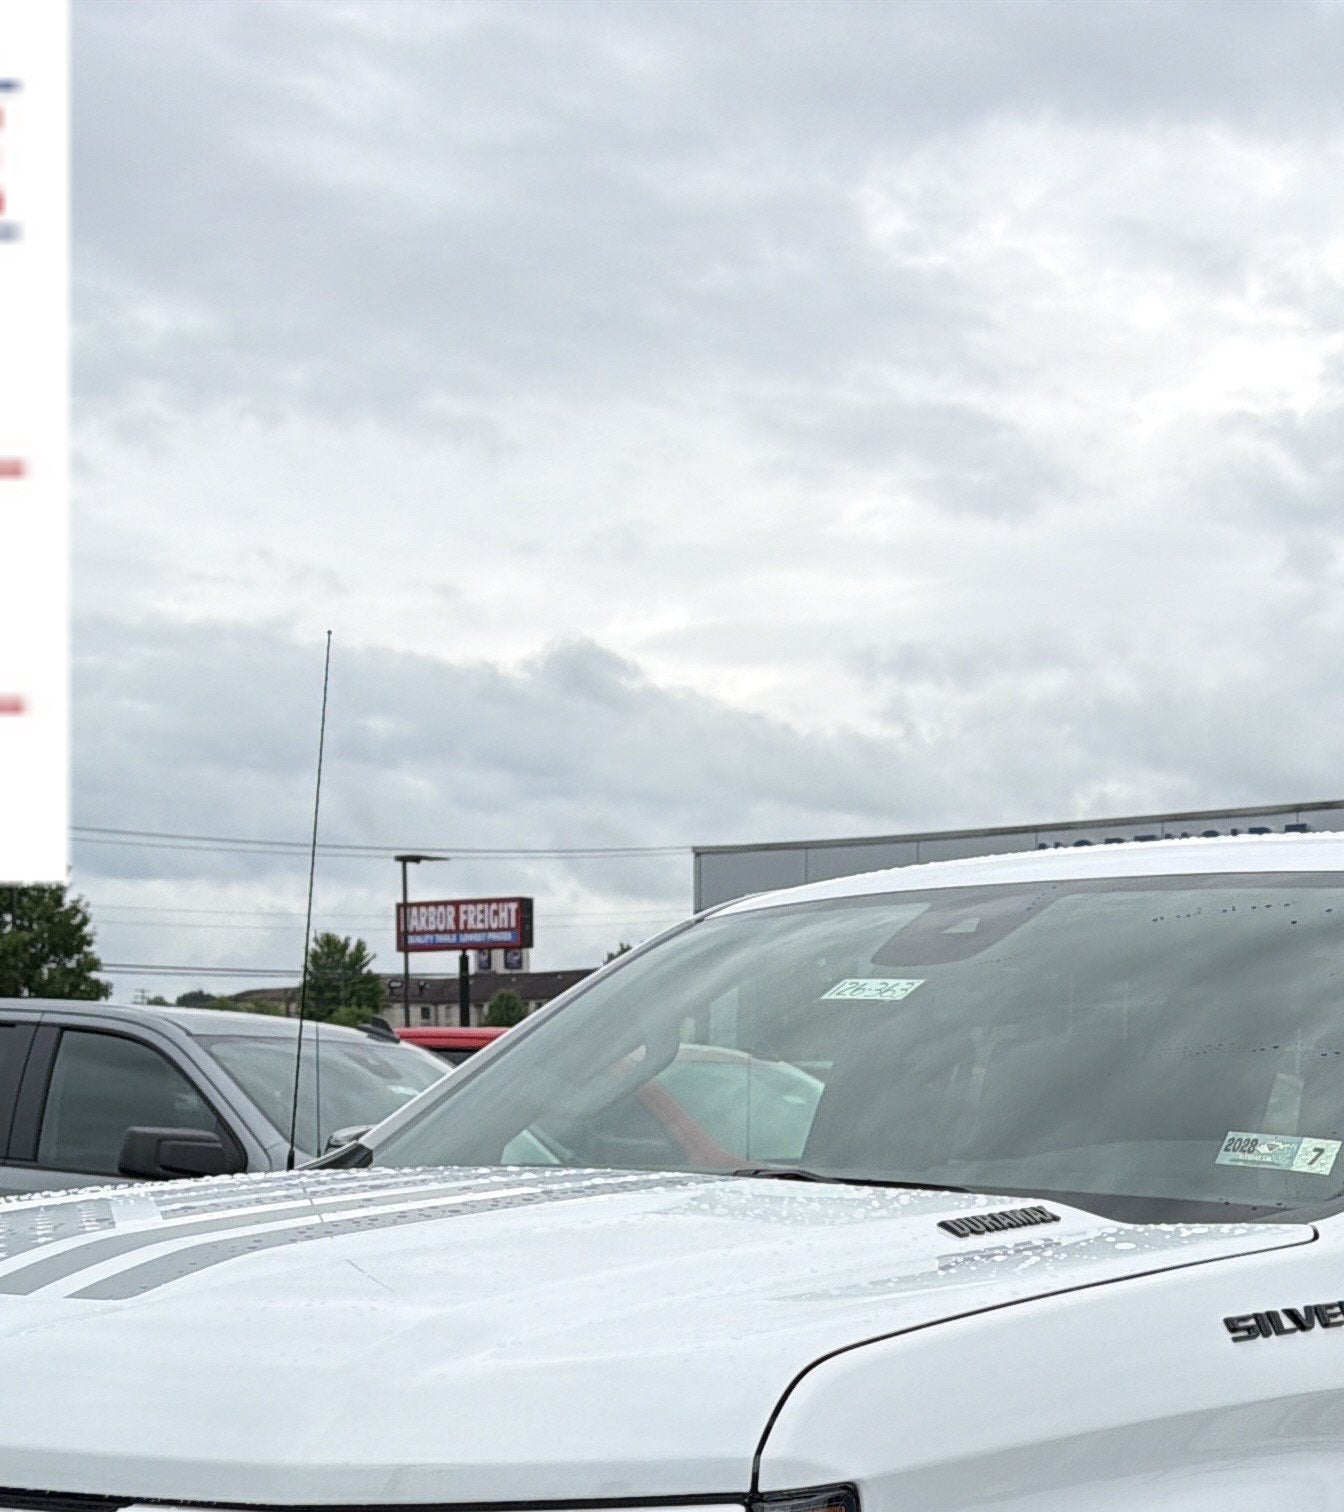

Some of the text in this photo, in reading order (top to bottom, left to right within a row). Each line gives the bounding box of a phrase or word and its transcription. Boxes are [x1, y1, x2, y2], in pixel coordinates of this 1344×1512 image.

[458, 902, 519, 930] FREIGHT
[1223, 1136, 1326, 1166] 2028 7
[936, 1205, 1062, 1239] DURAMAX
